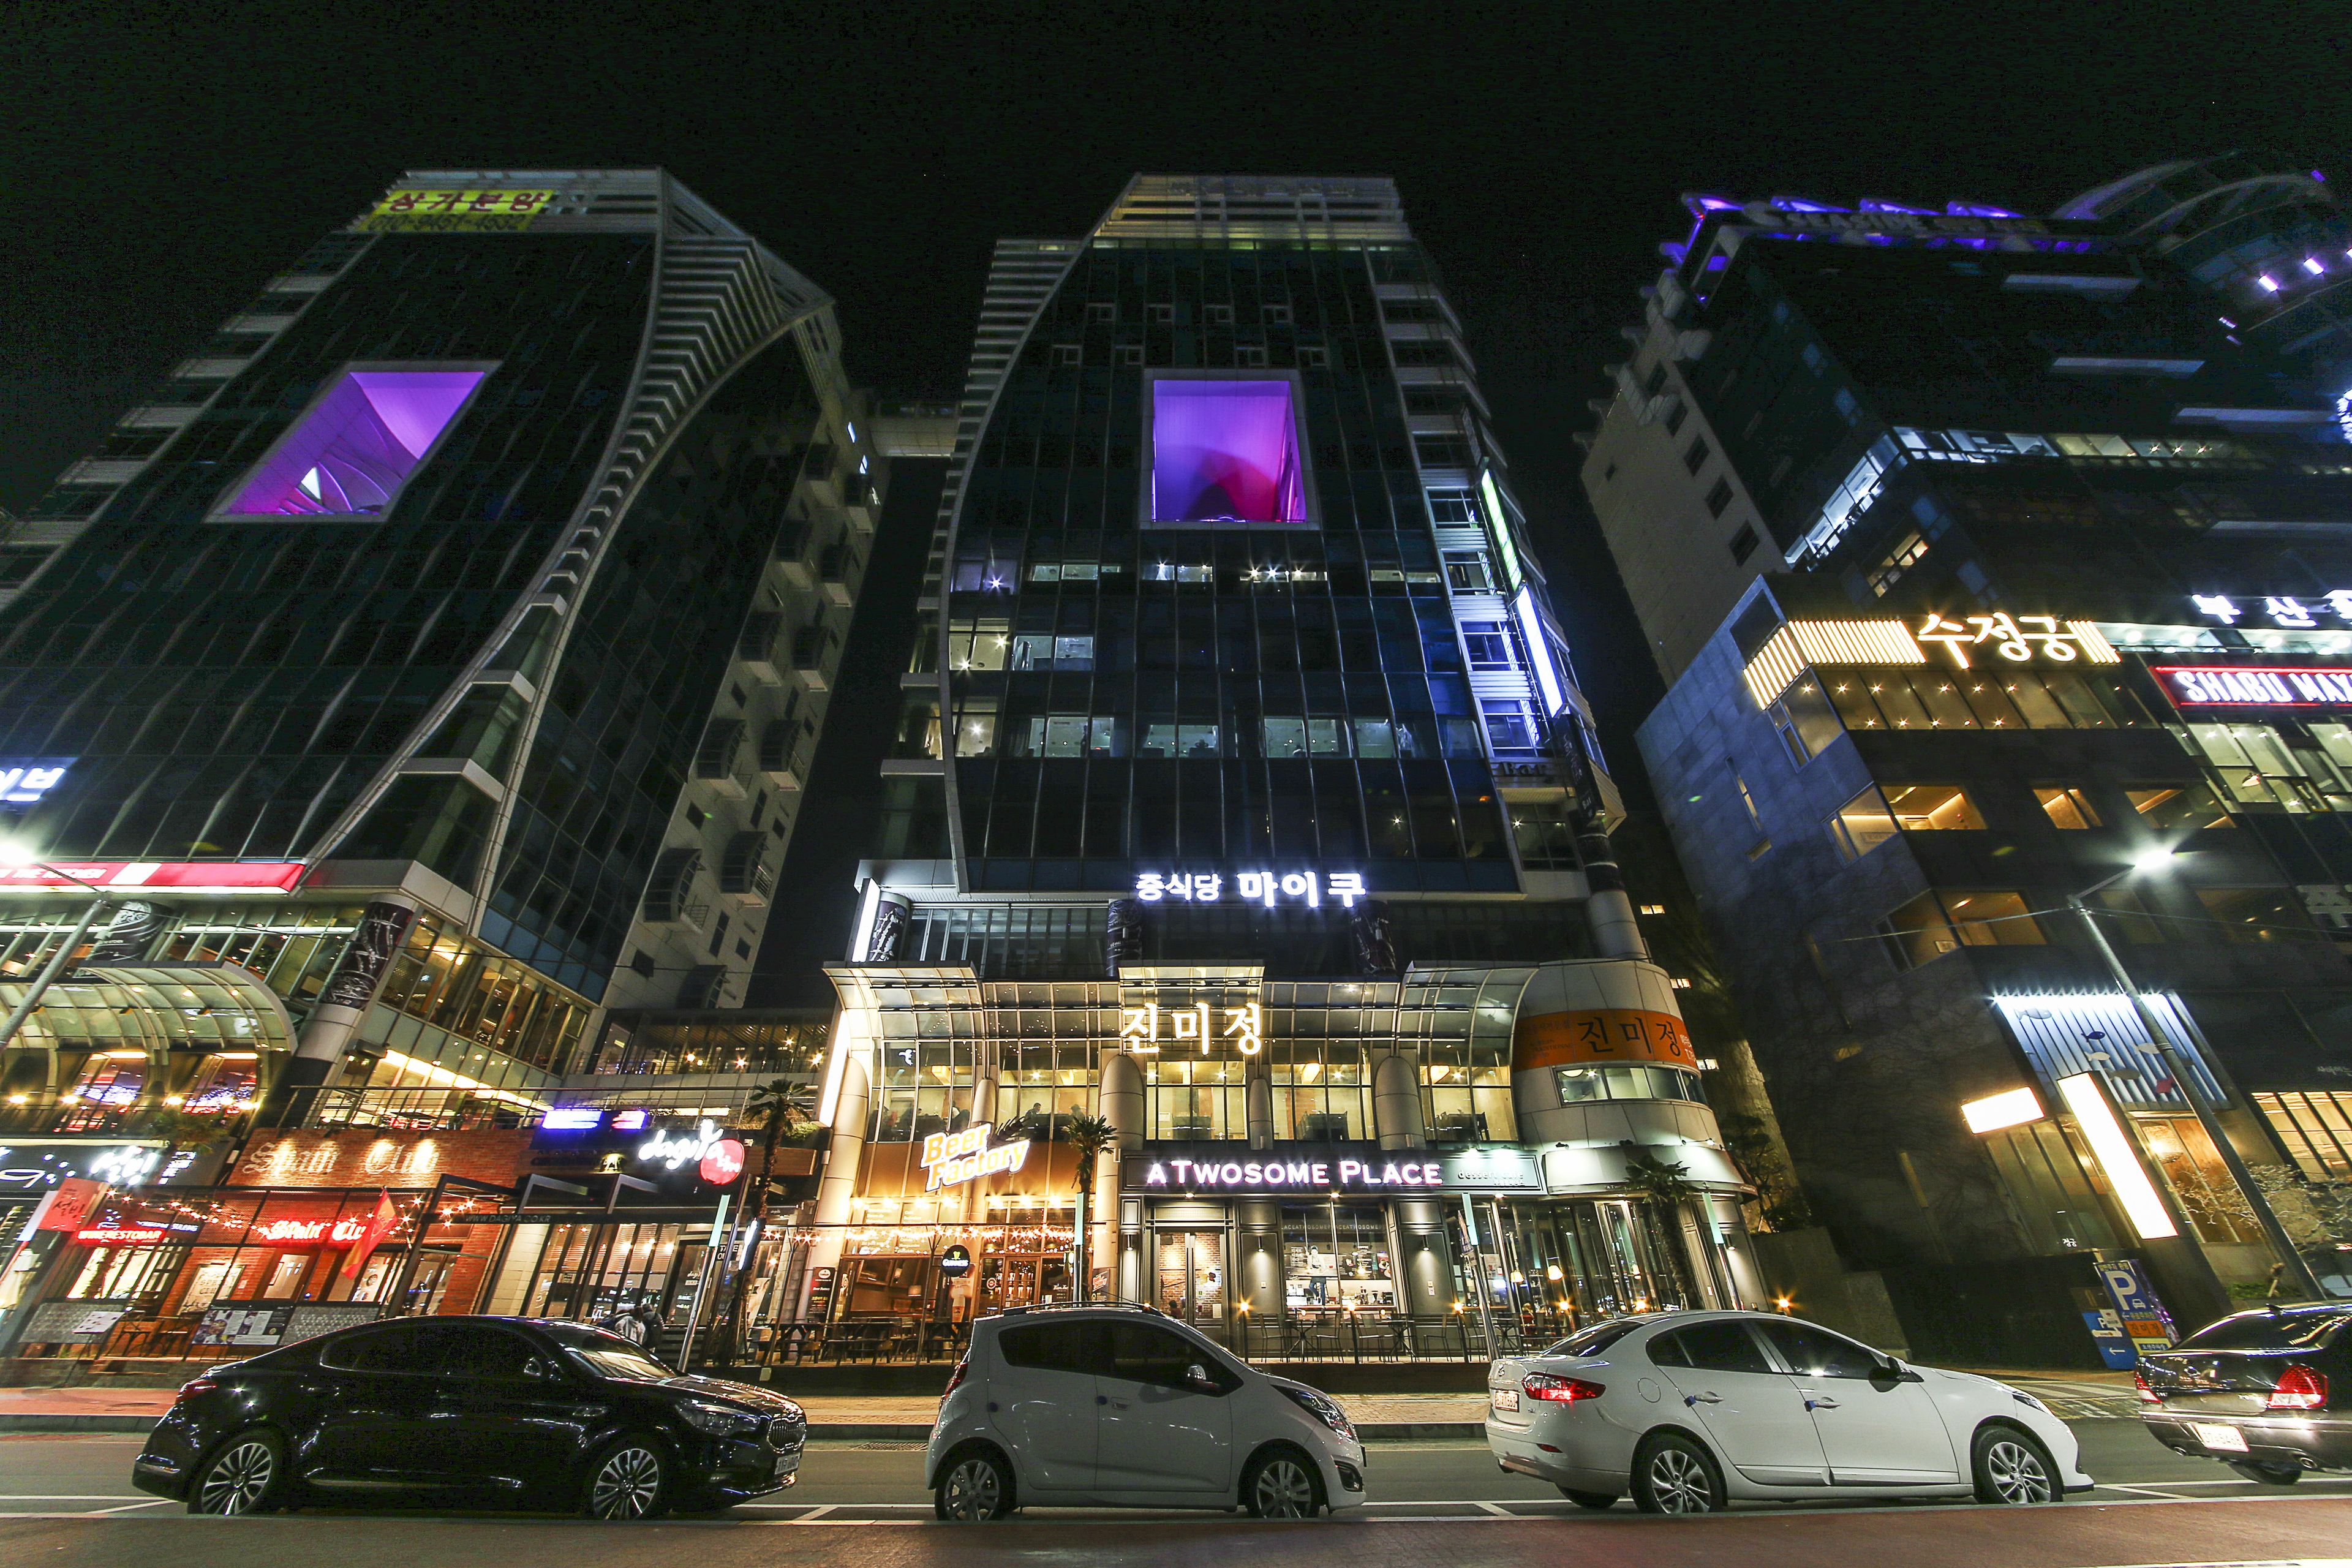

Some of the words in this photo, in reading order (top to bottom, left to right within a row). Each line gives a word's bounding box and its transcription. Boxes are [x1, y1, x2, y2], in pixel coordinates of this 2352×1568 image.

[390, 192, 549, 213] 상가분양
[1917, 611, 2078, 669] 수정궁
[2174, 671, 2293, 703] SHABU
[1236, 871, 1366, 908] 마이쿠
[1120, 1004, 1262, 1055] 진미정
[1577, 1017, 1681, 1057] 진미정
[243, 1140, 339, 1174] Spain
[922, 1123, 990, 1166] Beer
[927, 1140, 1029, 1191] Factory
[1147, 1163, 1167, 1185] A
[1170, 1159, 1330, 1185] TWOSOME
[1338, 1160, 1444, 1185] PLACE
[331, 1221, 366, 1241] Clu
[2105, 1270, 2137, 1310] P
[2128, 1322, 2162, 1335] 진미정
